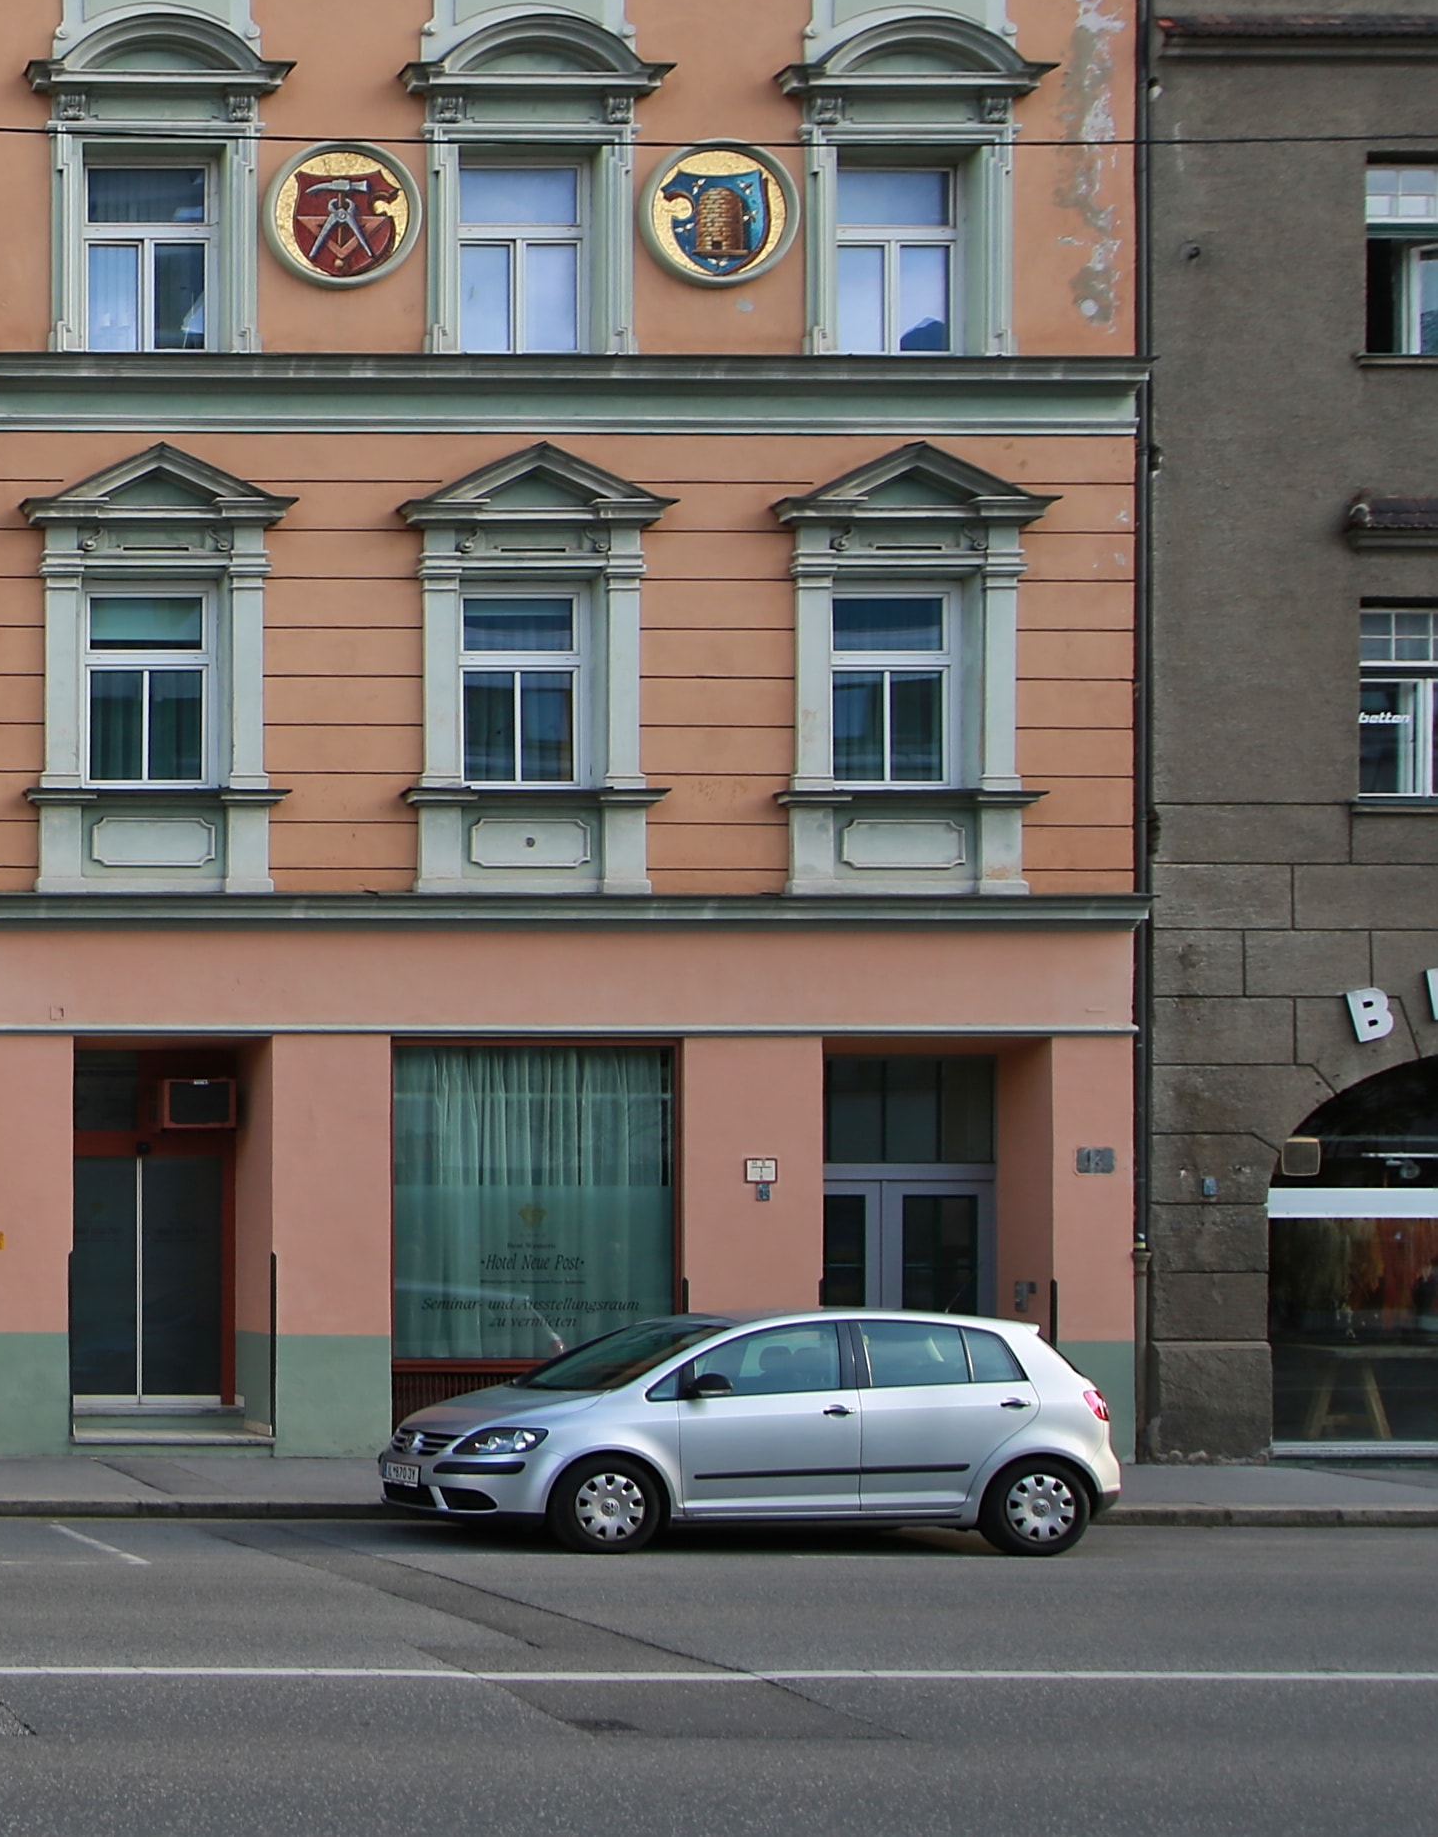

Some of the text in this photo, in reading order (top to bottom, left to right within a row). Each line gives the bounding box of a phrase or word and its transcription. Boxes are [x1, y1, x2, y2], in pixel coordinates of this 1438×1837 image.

[485, 1252, 580, 1271] Hotel Neue Post
[488, 1295, 515, 1311] und
